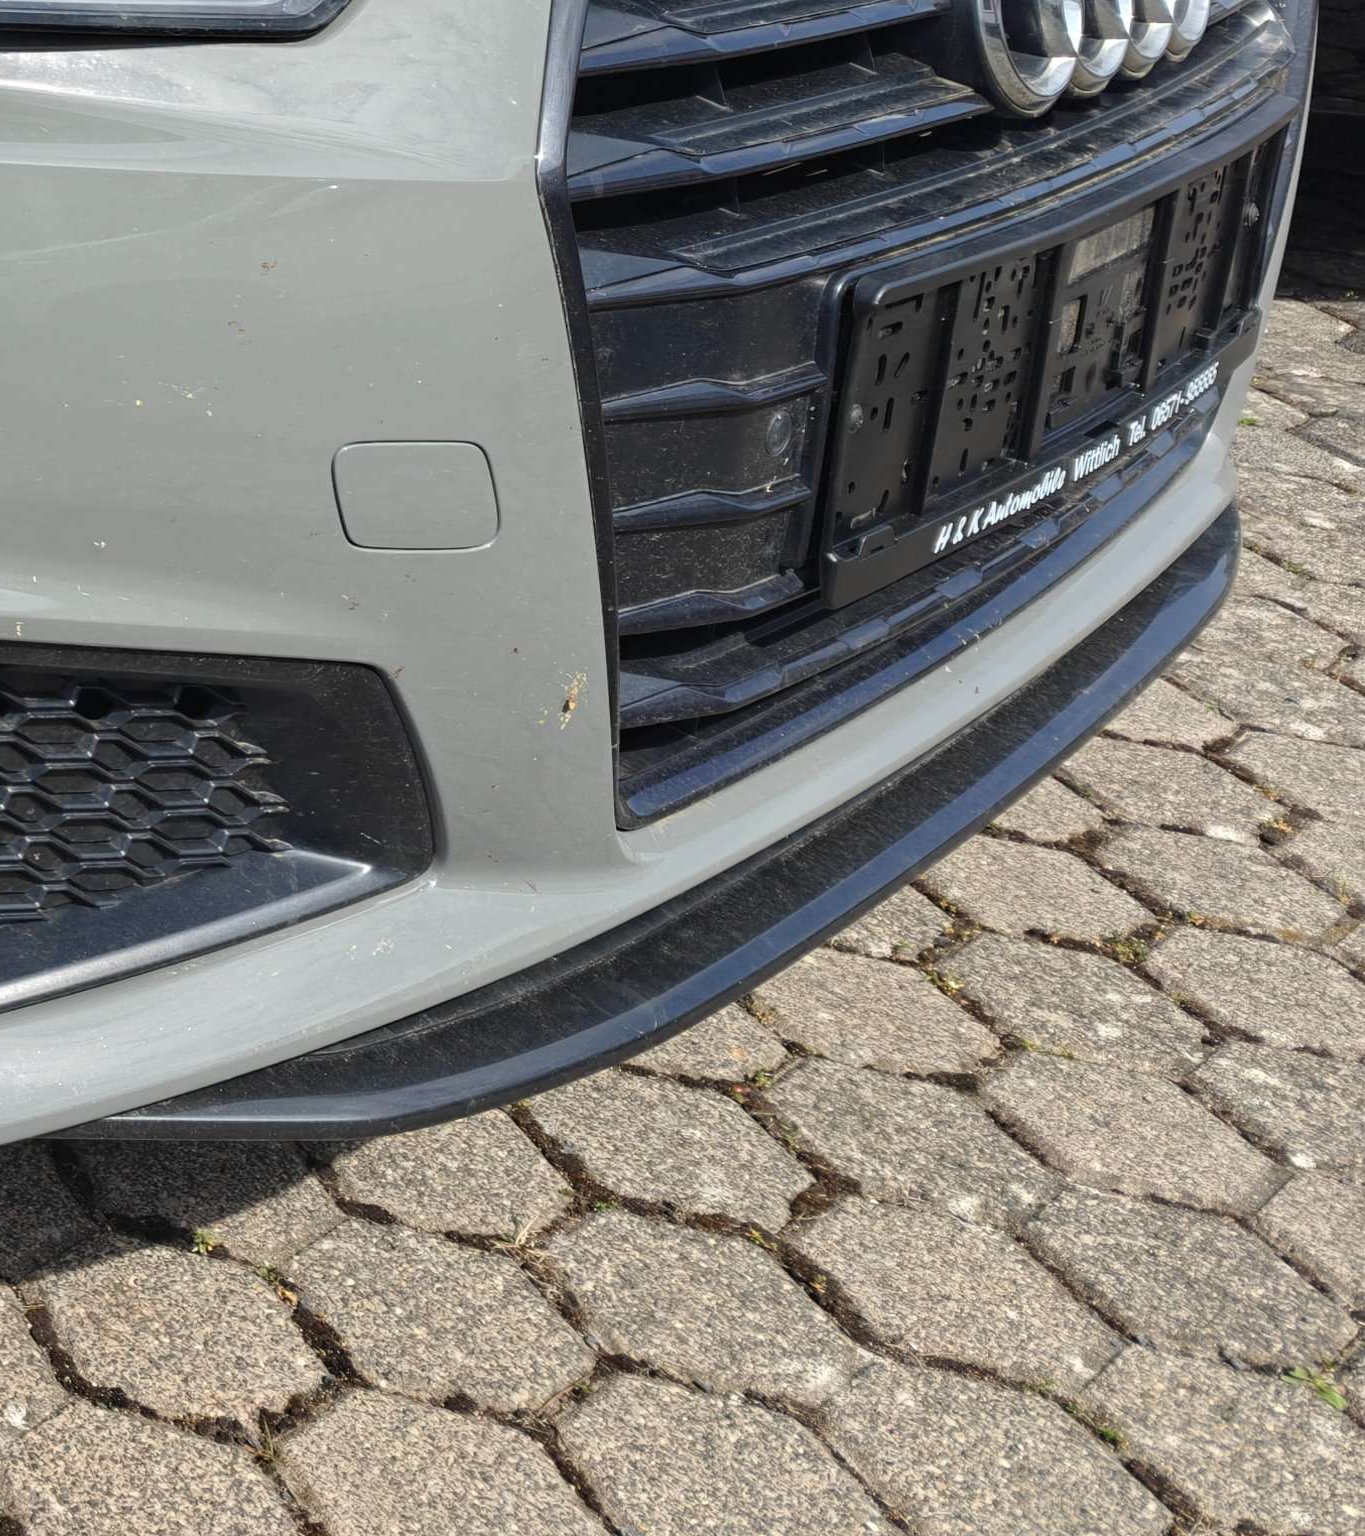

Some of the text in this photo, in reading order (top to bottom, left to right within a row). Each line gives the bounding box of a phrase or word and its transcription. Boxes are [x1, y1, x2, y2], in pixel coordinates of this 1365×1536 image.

[933, 522, 954, 554] H
[952, 516, 968, 544] &
[981, 466, 1067, 530] Automobile
[1073, 434, 1120, 482] Wittlich
[1128, 415, 1145, 446] Tel.
